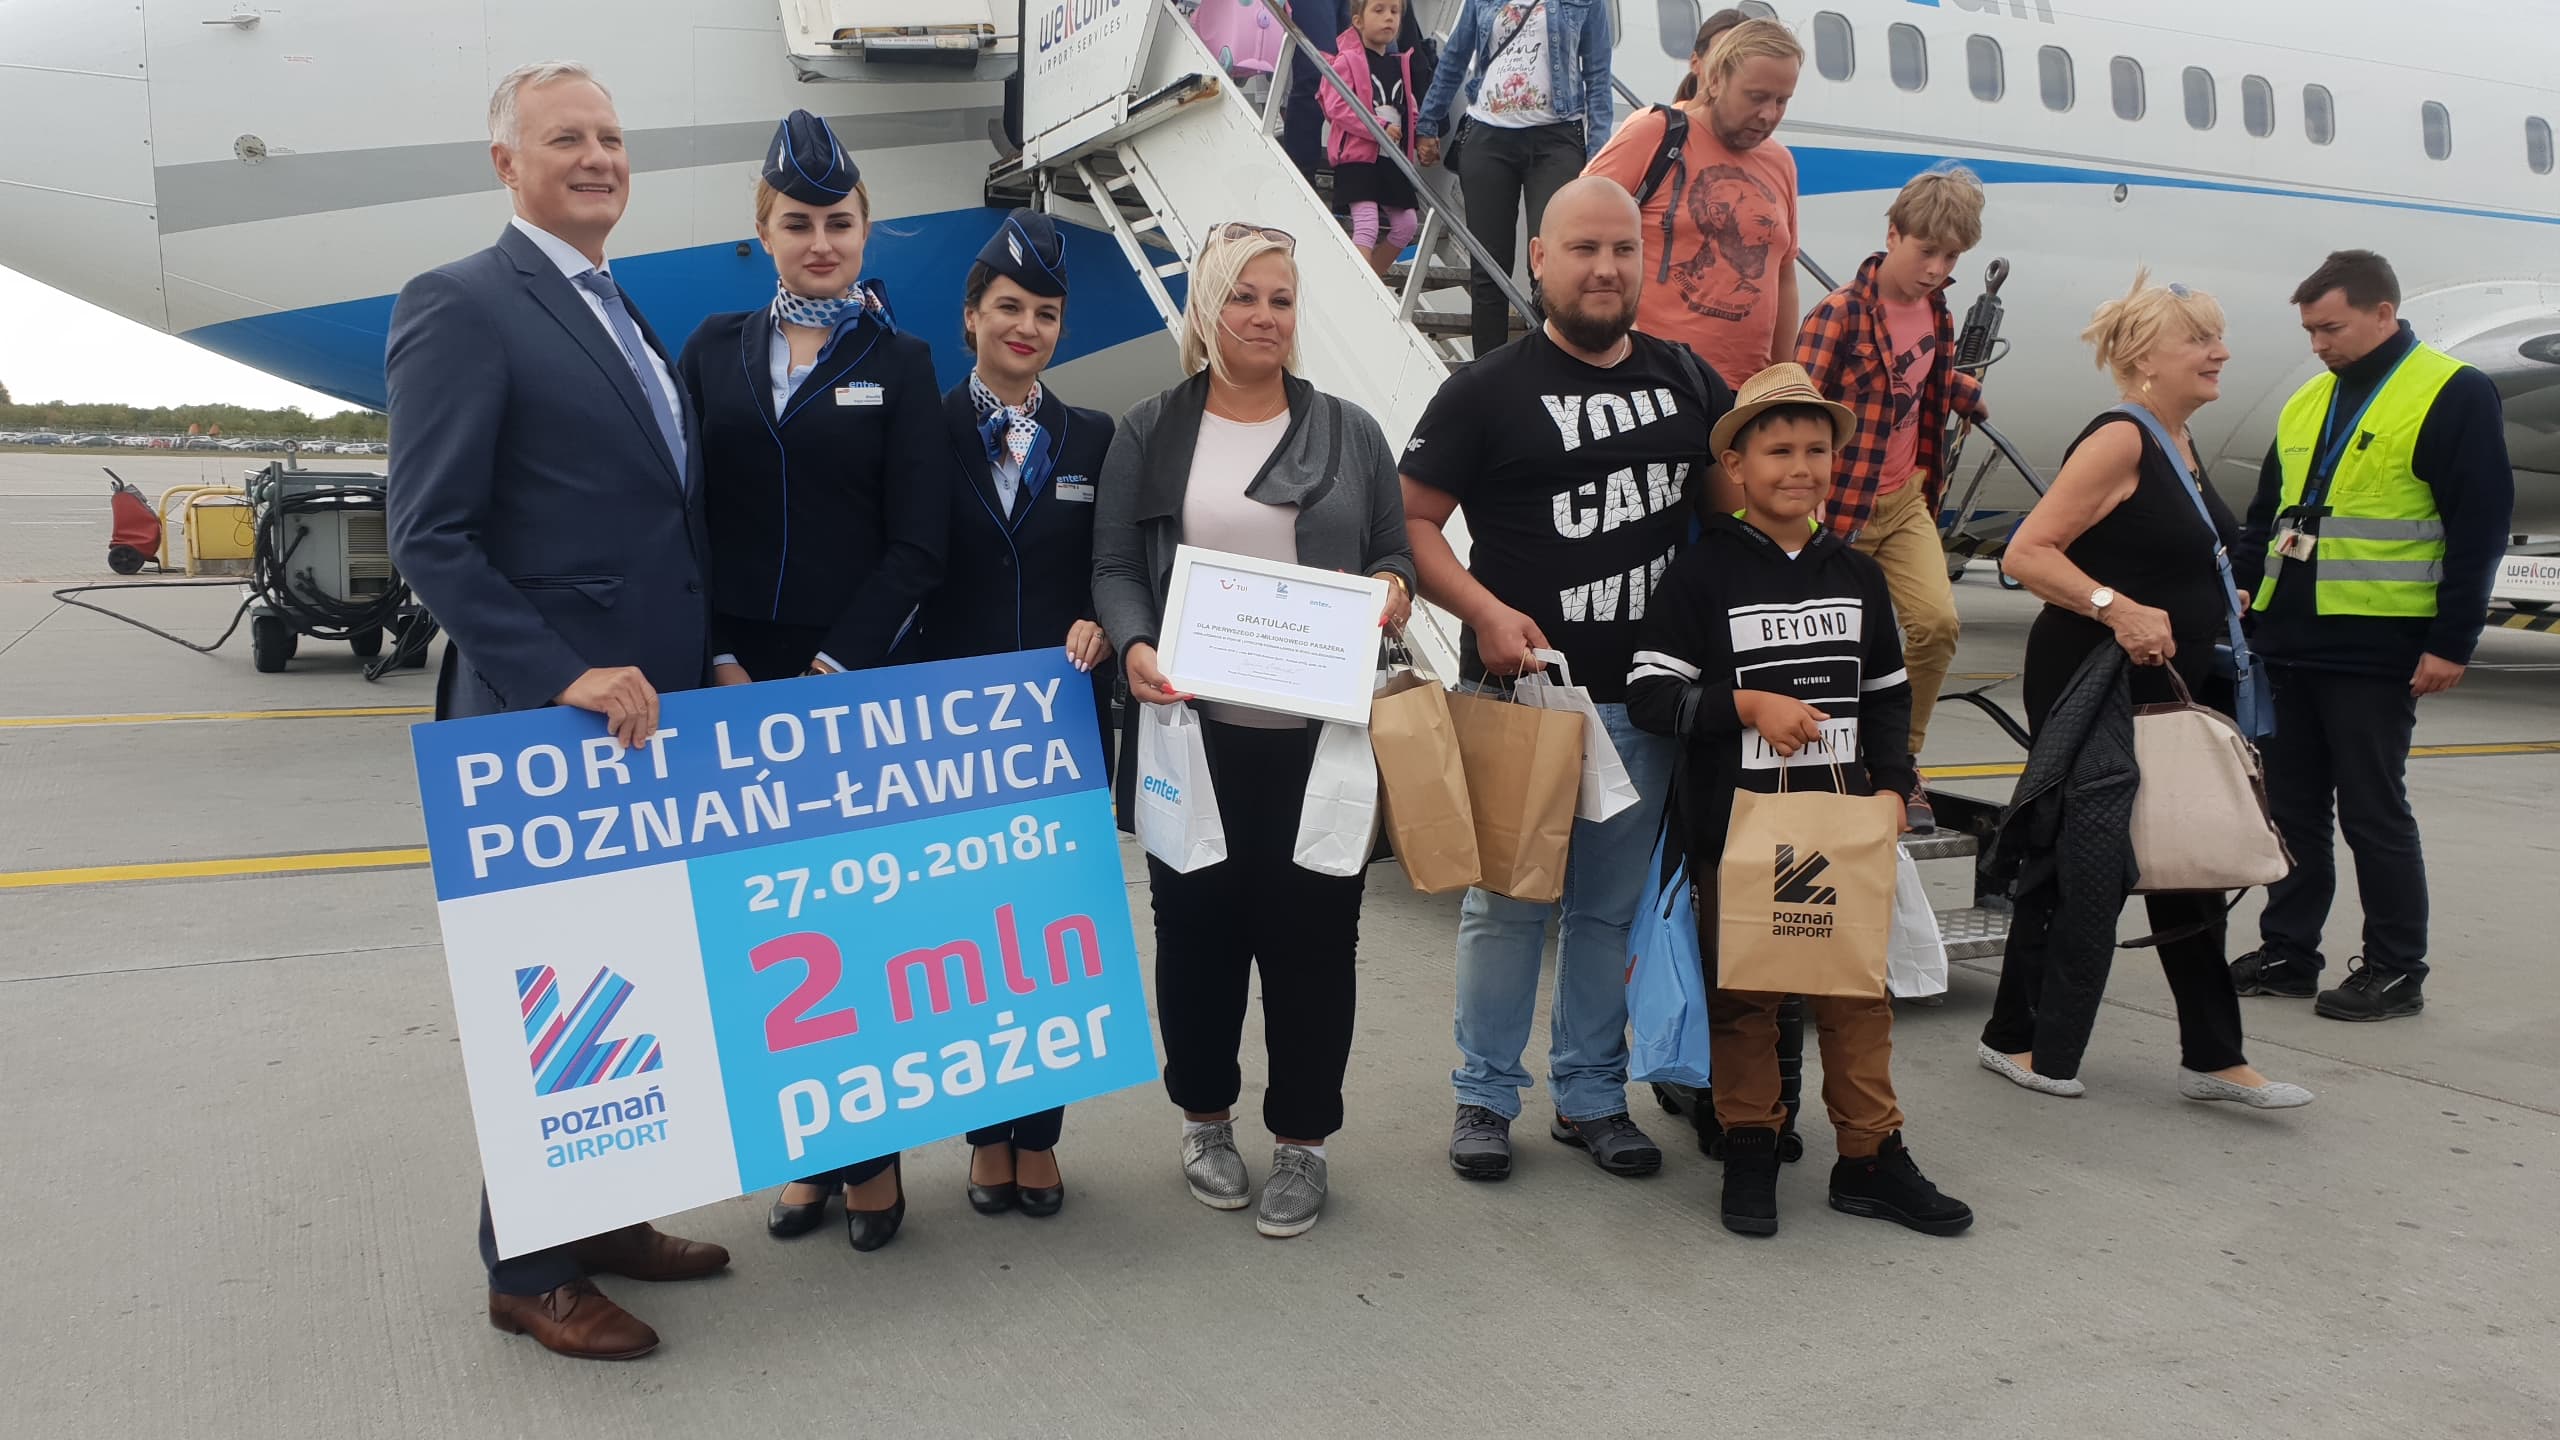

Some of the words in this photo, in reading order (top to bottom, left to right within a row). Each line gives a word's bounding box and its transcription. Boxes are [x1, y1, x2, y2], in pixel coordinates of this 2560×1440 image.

[1039, 46, 1074, 76] AIRPORT
[1077, 16, 1121, 54] SERVICES
[1040, 0, 1120, 53] welco
[1552, 462, 1690, 539] CAN
[2507, 562, 2560, 579] welco
[1236, 613, 1311, 634] GRATULACJE
[1761, 612, 1847, 641] BEYOND
[456, 727, 678, 807] PORT
[715, 678, 1061, 769] LOTNICZY
[1144, 775, 1180, 802] enter
[744, 815, 1077, 918] 27.09.2018r.
[749, 931, 859, 1054] 2
[885, 903, 1104, 1024] mln
[777, 1003, 1112, 1161] pasażer
